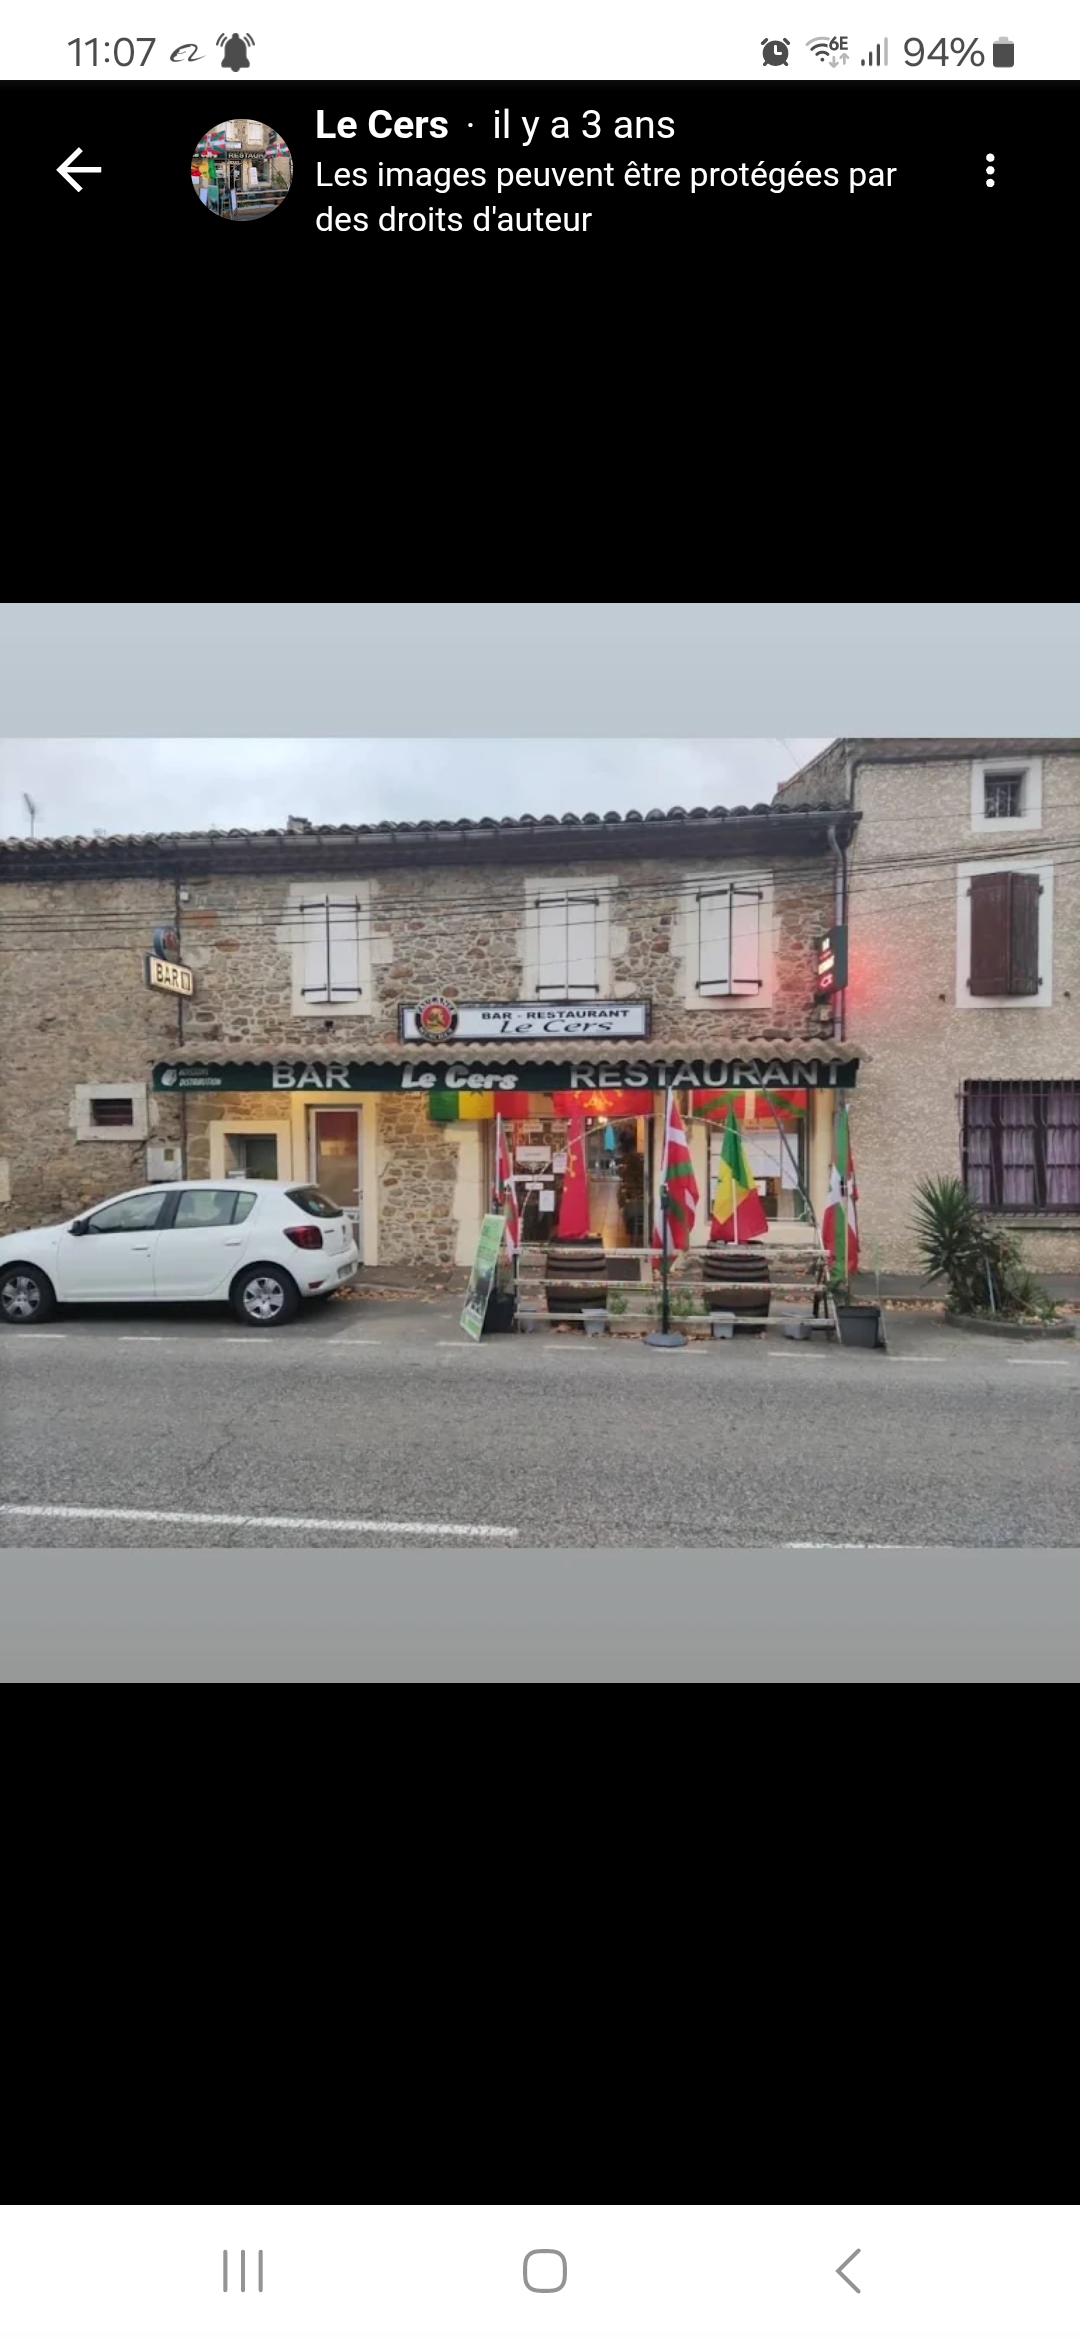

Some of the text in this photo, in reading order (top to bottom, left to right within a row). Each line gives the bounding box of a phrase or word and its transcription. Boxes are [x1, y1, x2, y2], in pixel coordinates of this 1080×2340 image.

[156, 962, 179, 988] BAR
[481, 1011, 512, 1020] BAR
[526, 1010, 630, 1020] RESTAURANT
[500, 1019, 614, 1034] Le Cers
[272, 1064, 351, 1088] BAR
[401, 1064, 519, 1090] Le Cers
[570, 1061, 841, 1089] RESTAURANT
